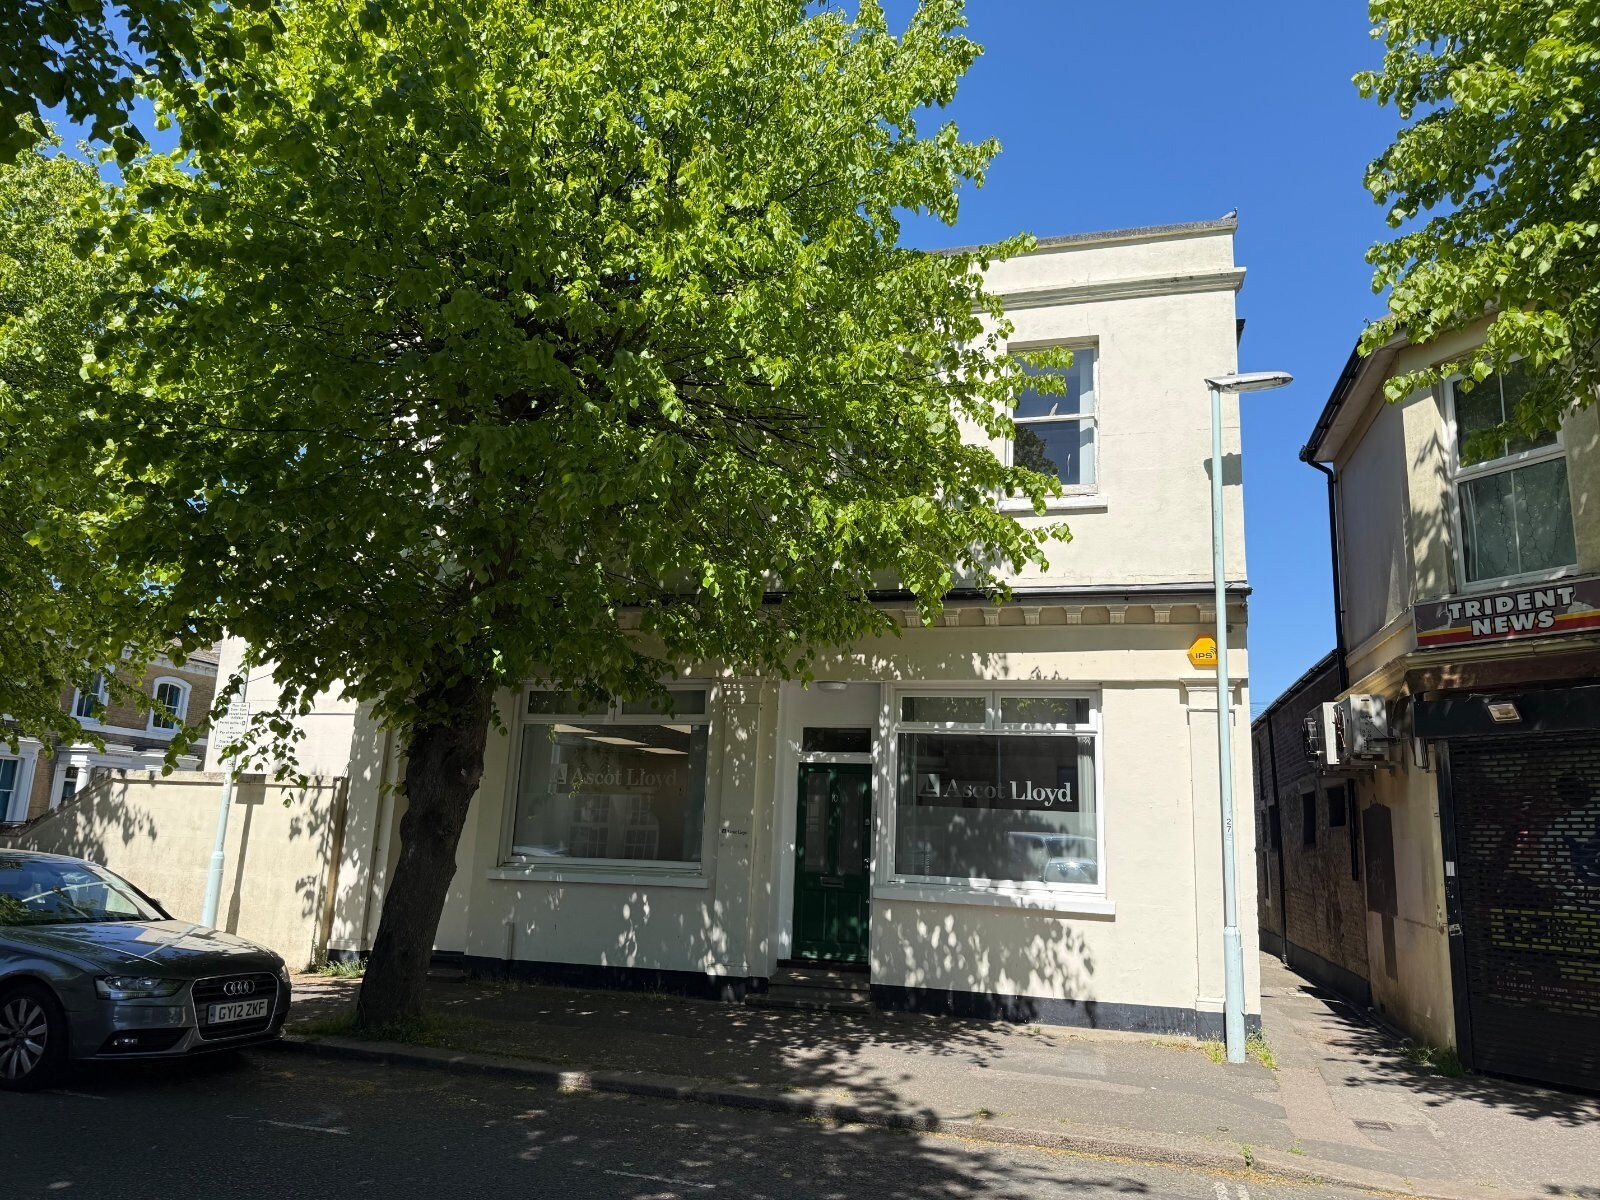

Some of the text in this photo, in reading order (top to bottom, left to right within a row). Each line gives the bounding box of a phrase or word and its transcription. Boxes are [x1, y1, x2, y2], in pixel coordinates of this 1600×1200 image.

[1448, 586, 1574, 620] TRIDENT
[1471, 610, 1555, 636] NEWS
[569, 767, 677, 790] Ascot Lloyd
[943, 778, 1073, 807] Ascot Lloyd
[1226, 818, 1232, 833] 27
[218, 1001, 265, 1020] GY12 ZKF
